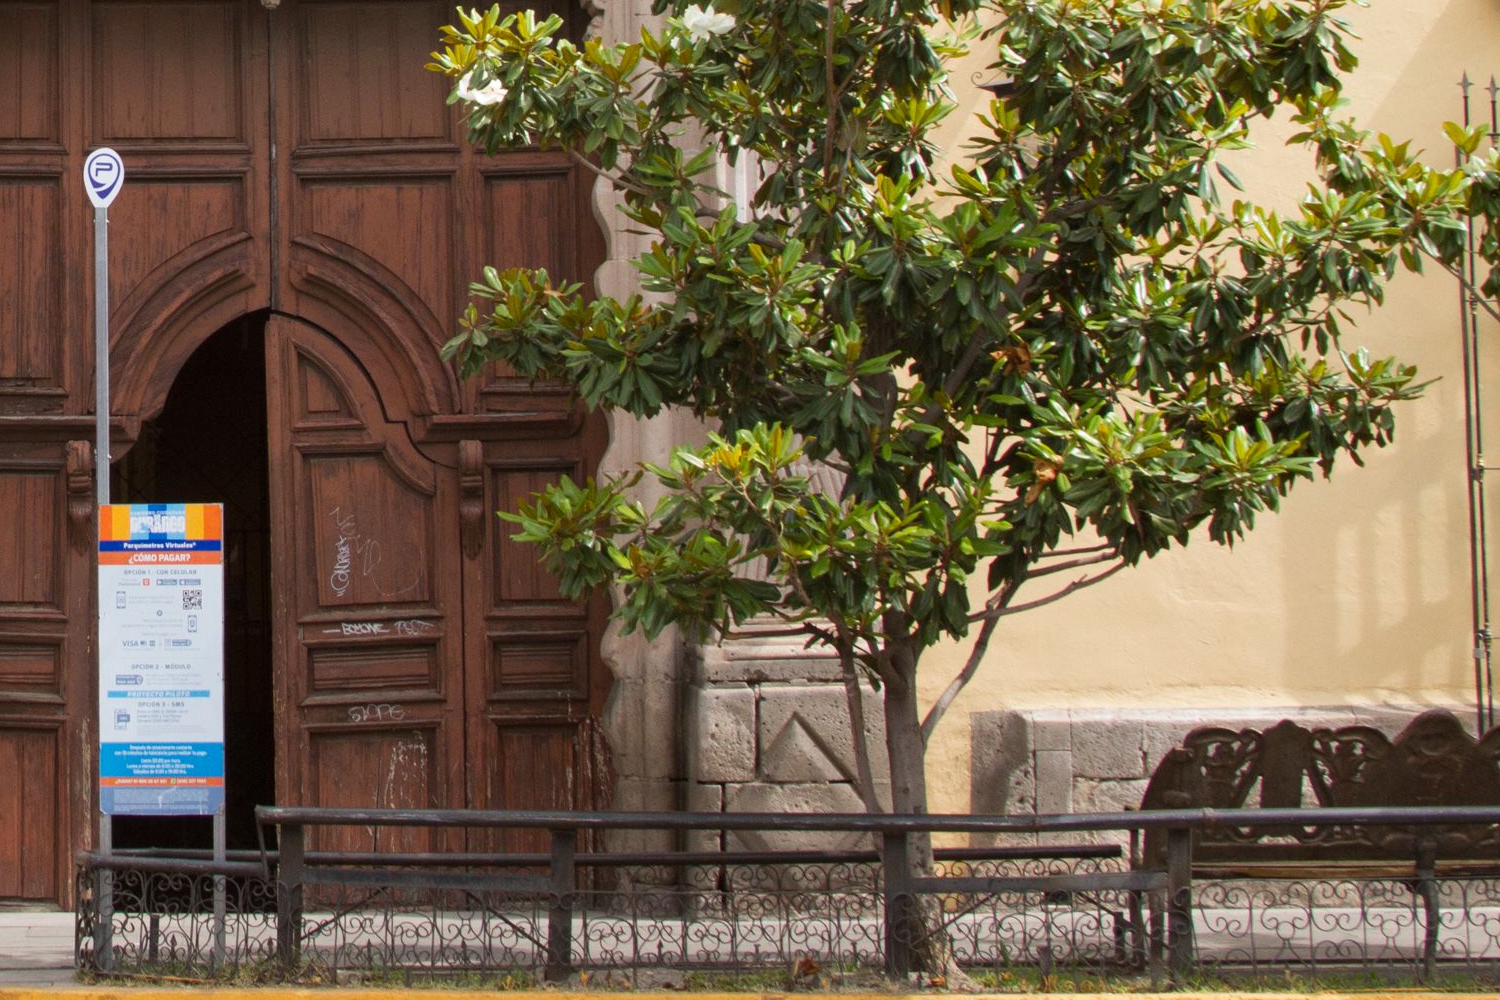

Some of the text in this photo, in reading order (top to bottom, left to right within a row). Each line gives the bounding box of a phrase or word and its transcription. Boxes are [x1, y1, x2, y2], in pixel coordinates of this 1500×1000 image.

[95, 162, 113, 177] P
[130, 516, 186, 533] DURANGO
[128, 553, 191, 564] ¿CÓMO PAGAR?
